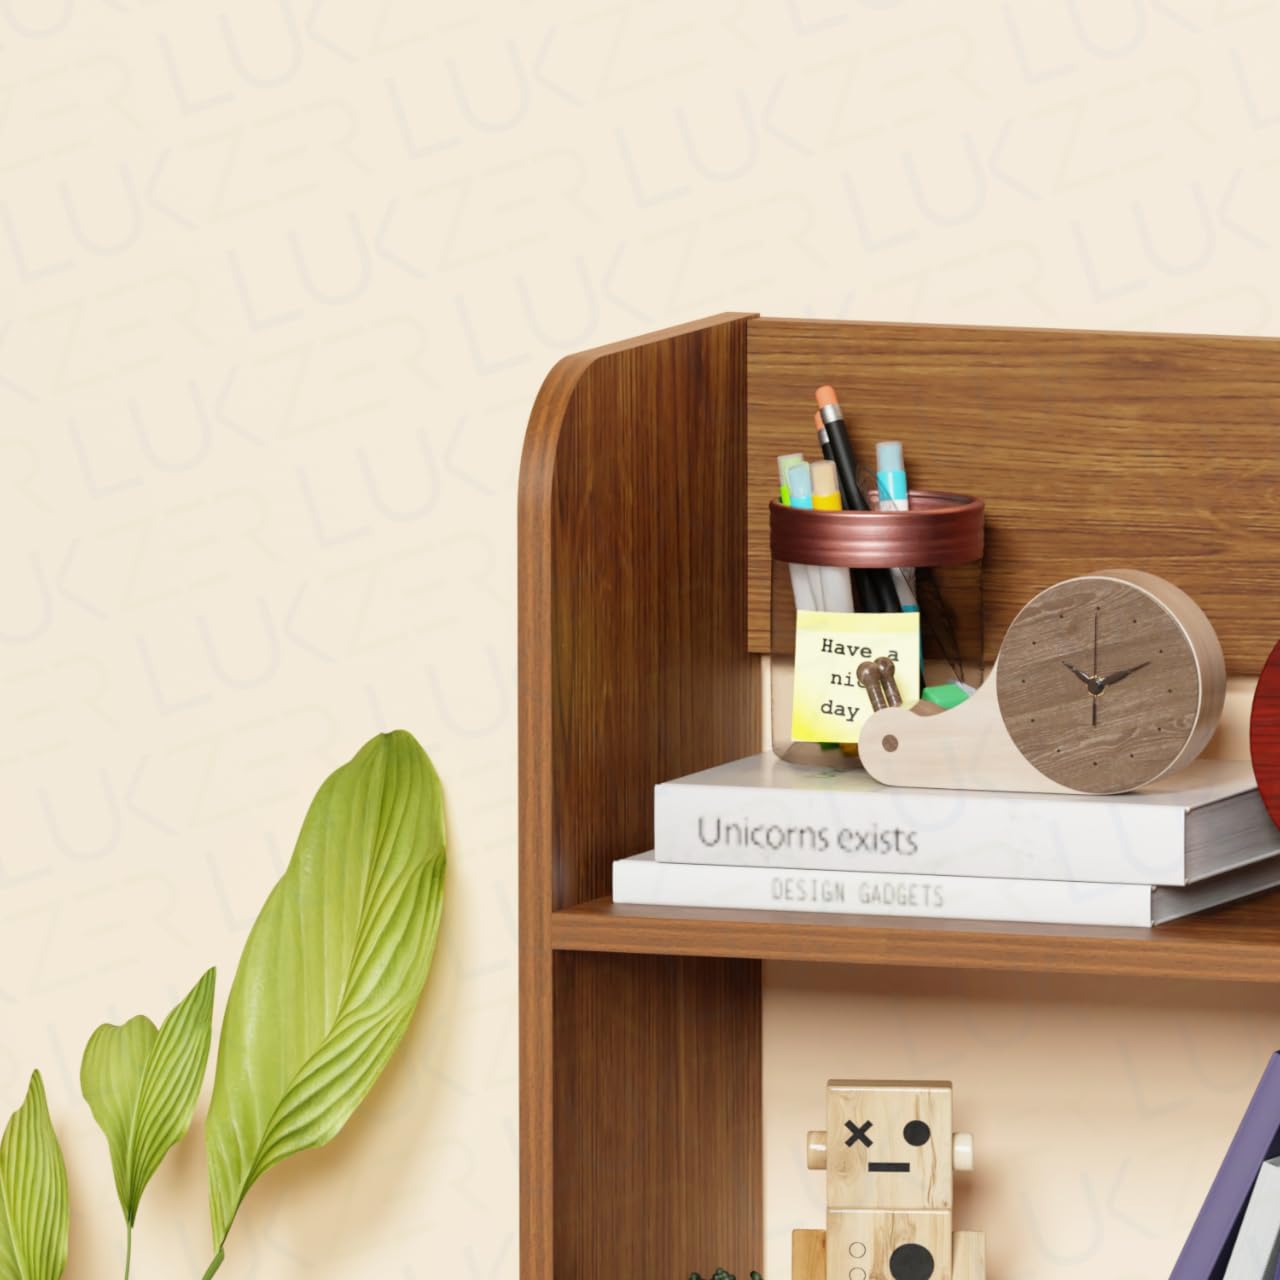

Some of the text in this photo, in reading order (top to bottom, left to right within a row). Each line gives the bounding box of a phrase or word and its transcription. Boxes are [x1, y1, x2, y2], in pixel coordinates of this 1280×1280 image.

[821, 638, 900, 662] Have a
[820, 700, 860, 722] day
[698, 816, 919, 856] Unicorns exists
[771, 876, 945, 908] DESIGN GADGETS
